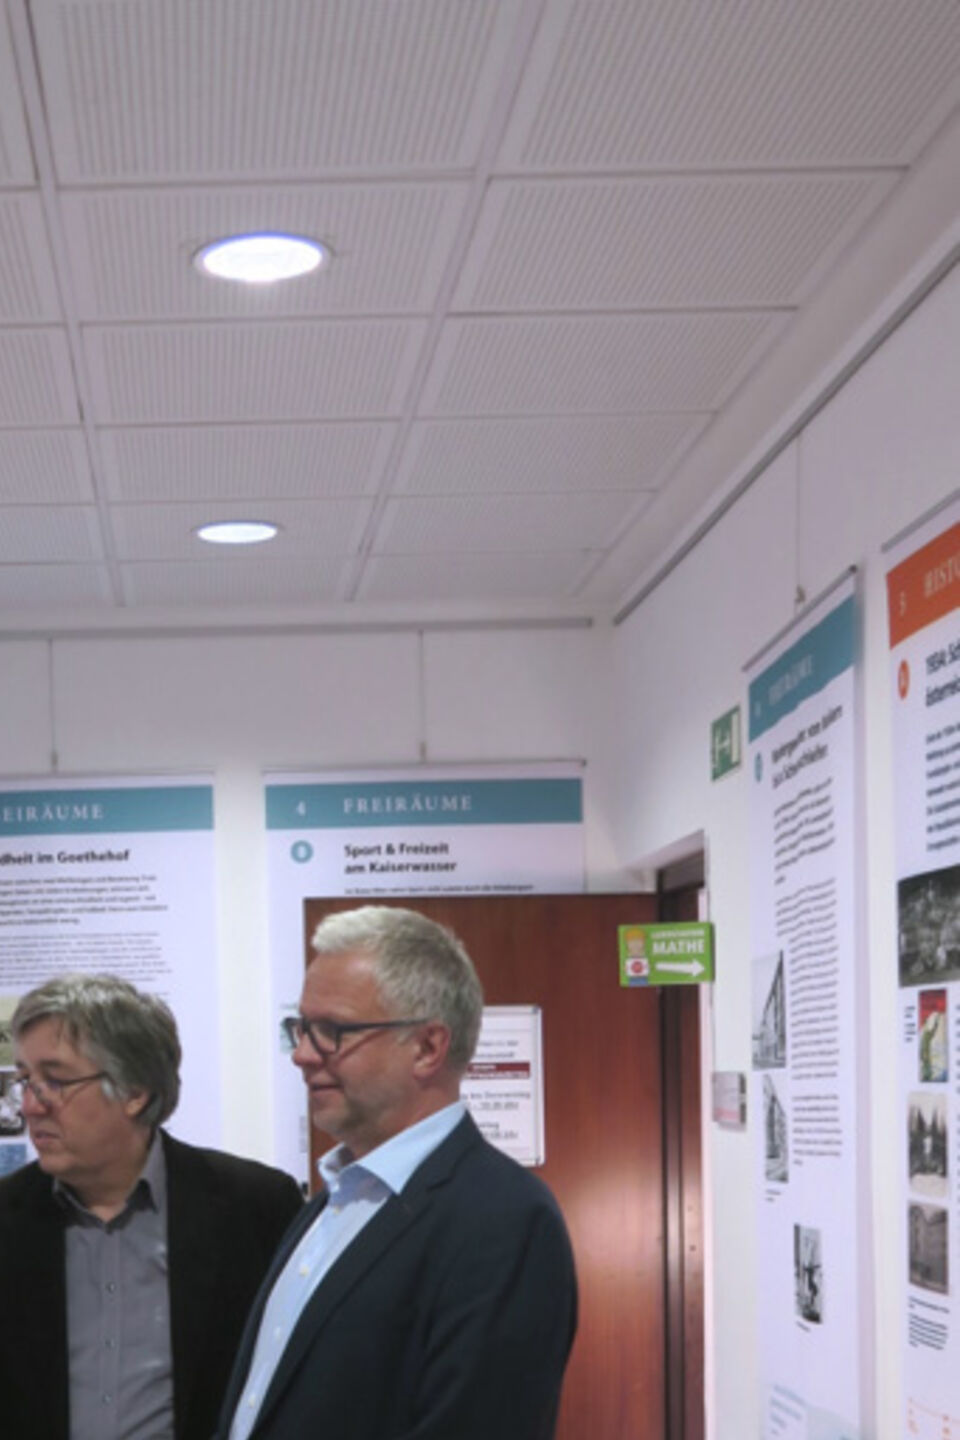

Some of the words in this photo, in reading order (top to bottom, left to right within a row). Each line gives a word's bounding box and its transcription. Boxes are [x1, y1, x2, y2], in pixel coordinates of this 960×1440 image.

[296, 801, 307, 816] 4
[343, 795, 473, 814] FREIRÄUME
[37, 851, 54, 864] im
[57, 848, 130, 864] Goethehof
[344, 844, 382, 859] Sport
[386, 843, 396, 855] &
[399, 842, 450, 855] Freizeit
[345, 863, 366, 875] am
[369, 861, 457, 874] Kaiserwasser
[653, 940, 705, 954] MATHE
